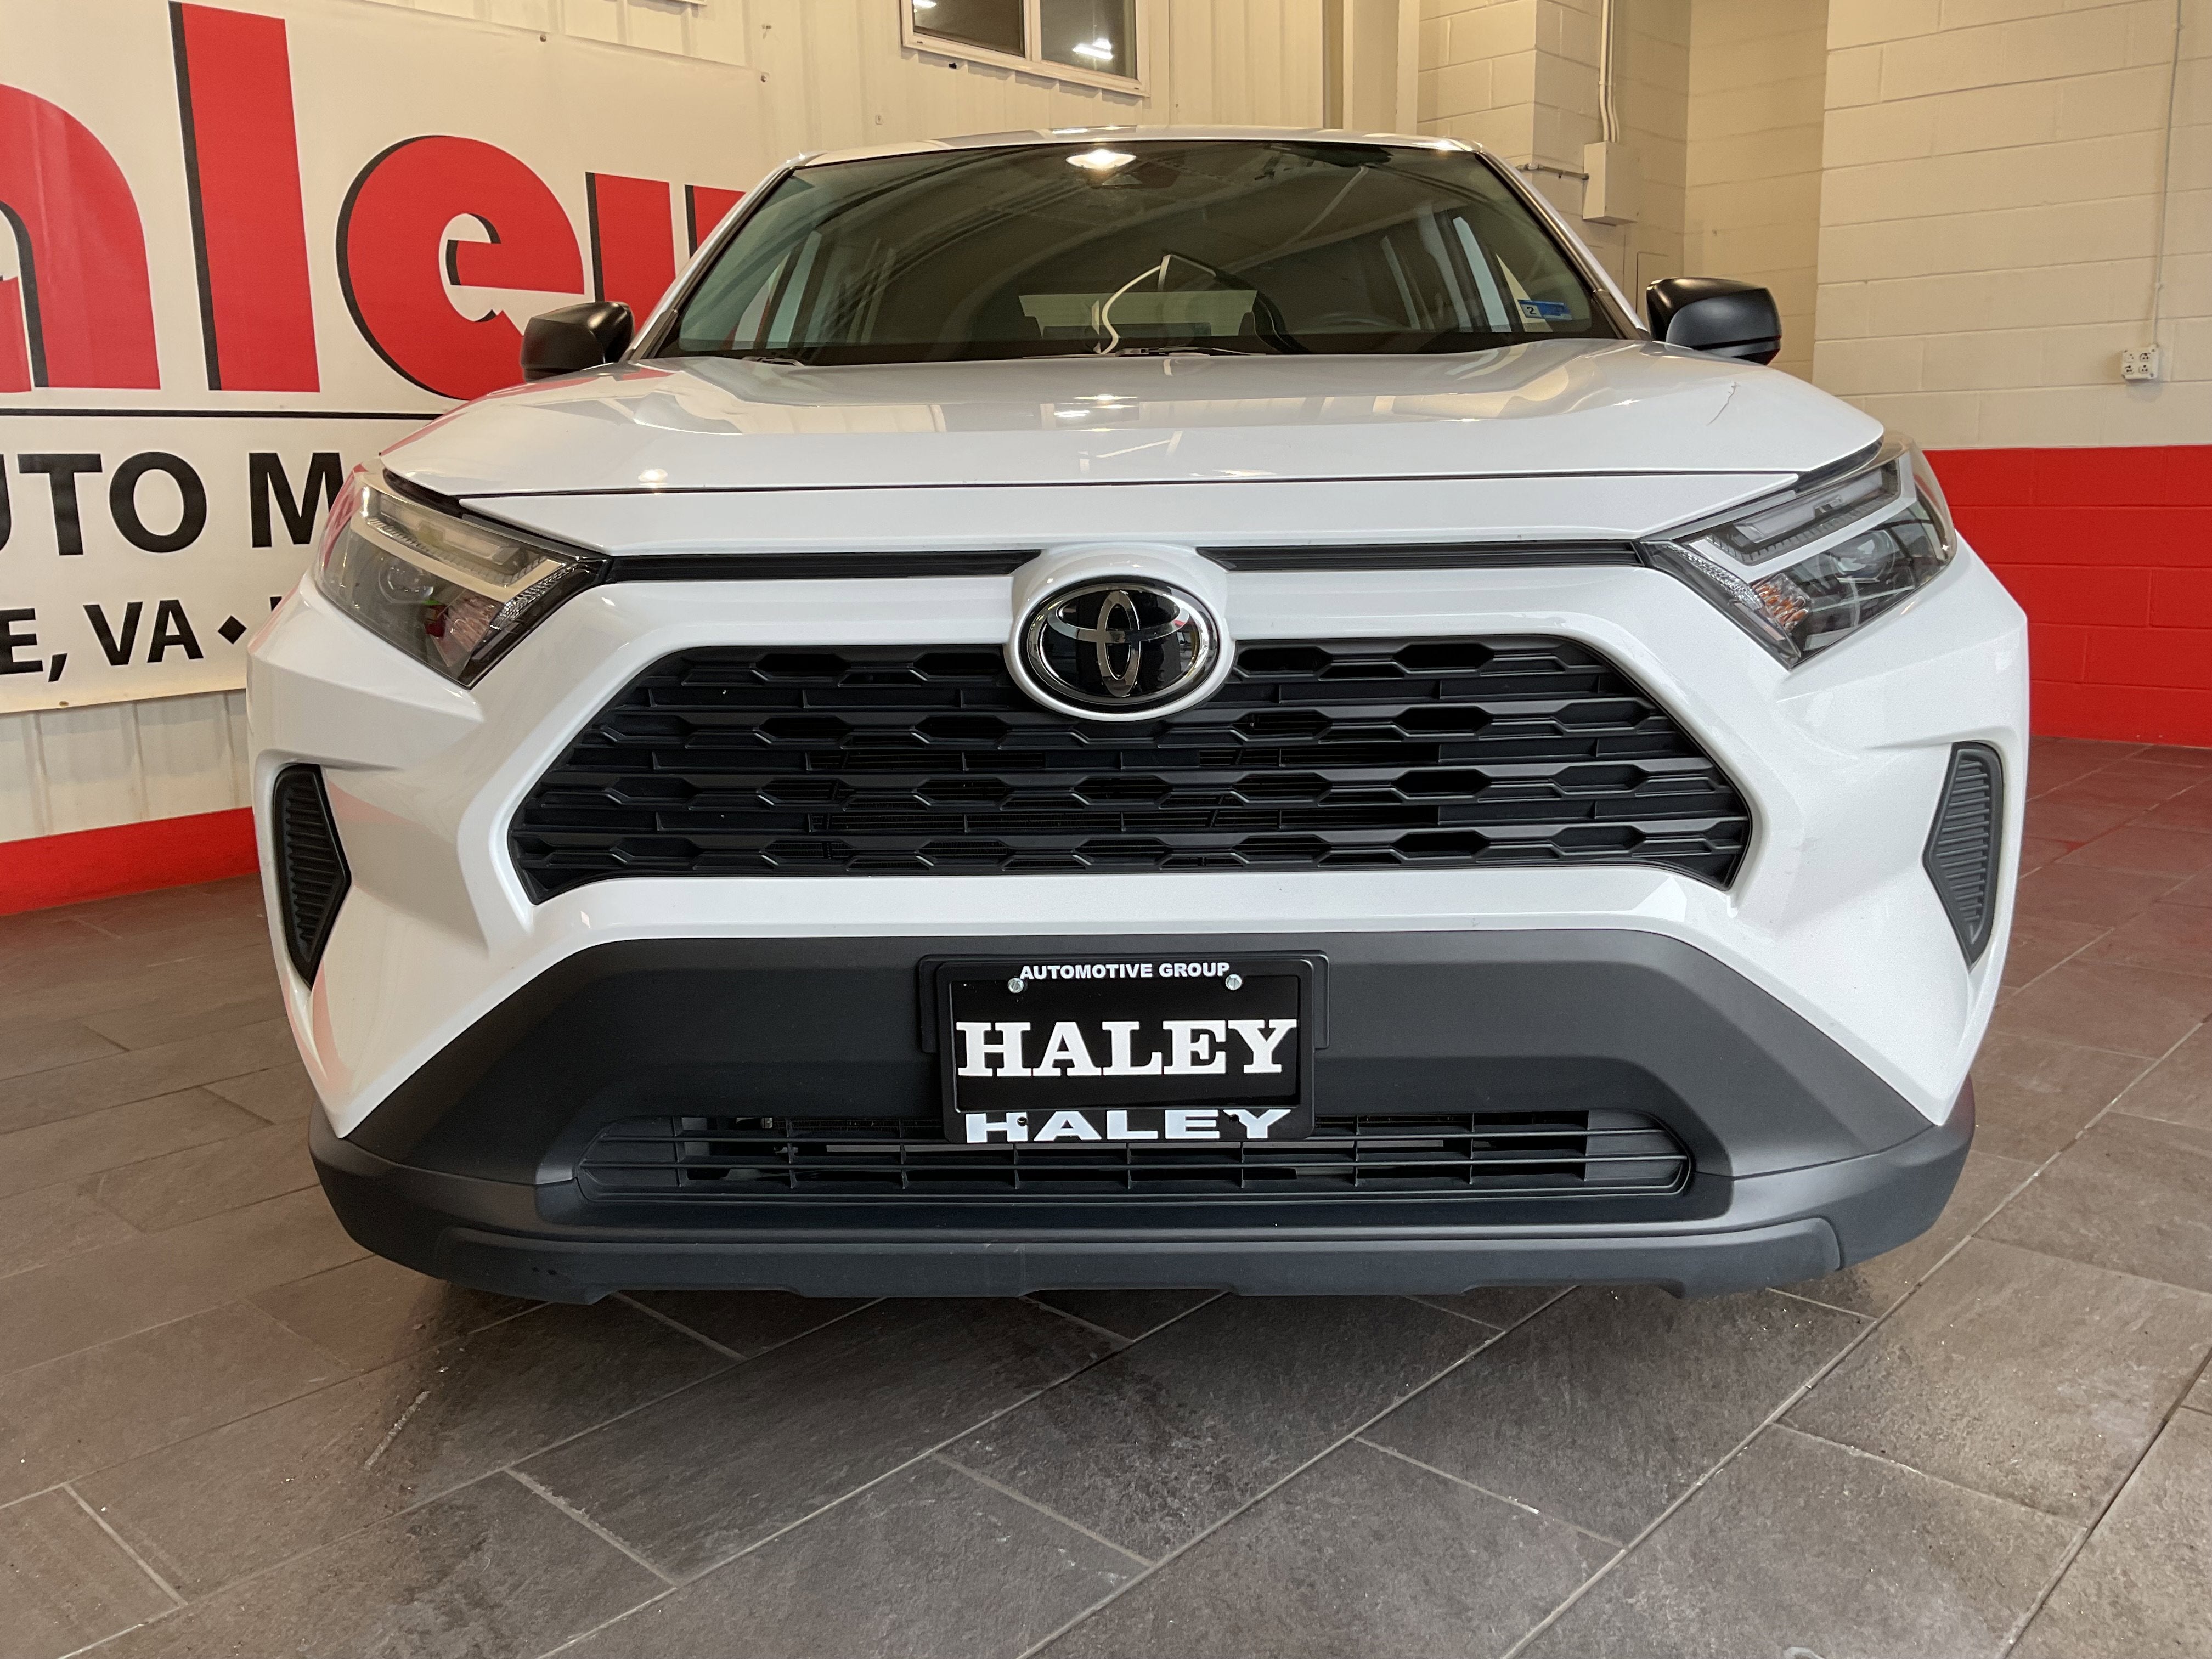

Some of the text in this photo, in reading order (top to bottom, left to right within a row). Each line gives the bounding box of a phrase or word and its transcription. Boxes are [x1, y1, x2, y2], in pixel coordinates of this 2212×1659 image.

[0, 452, 207, 556] TO
[1019, 962, 1230, 979] AUTOMOTIVE GROUP
[956, 1019, 1297, 1076] HALEY
[966, 1109, 1291, 1143] HALEY
